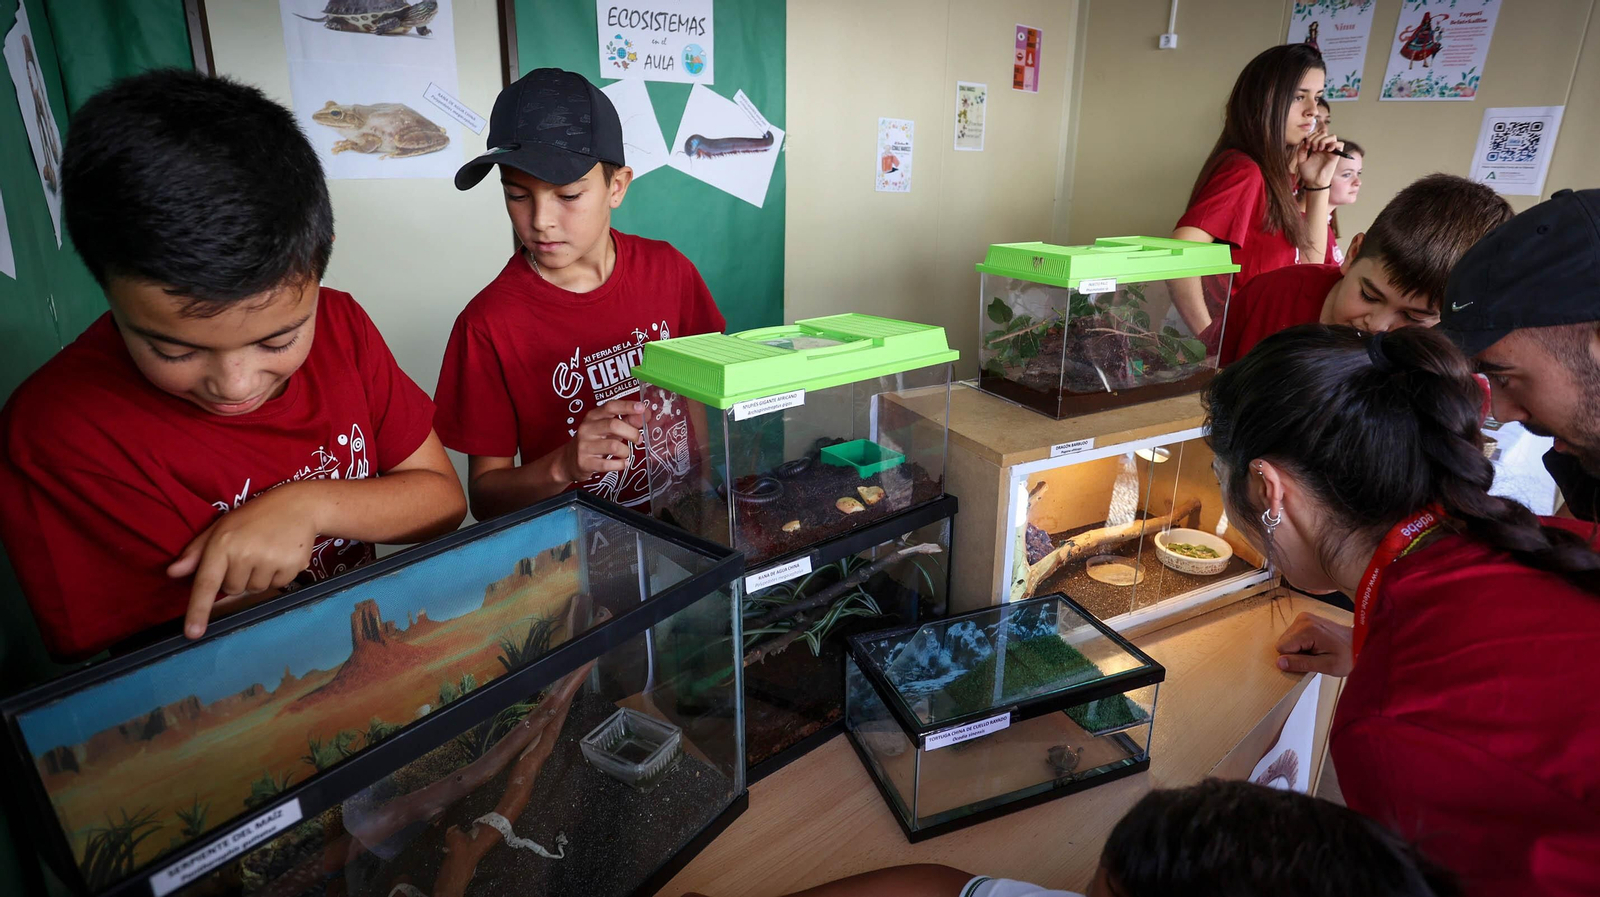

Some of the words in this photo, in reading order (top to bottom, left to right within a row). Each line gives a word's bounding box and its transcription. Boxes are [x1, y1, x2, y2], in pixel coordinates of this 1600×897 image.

[608, 6, 706, 36] ECOSISTEMAS
[644, 54, 674, 70] AULA
[592, 349, 612, 360] FERIA
[613, 344, 622, 352] DE
[622, 341, 632, 349] LA
[587, 348, 643, 390] CIENCI
[595, 392, 604, 400] EN
[605, 389, 614, 397] LA
[614, 382, 632, 393] CALLE
[759, 398, 776, 406] GIGANTE
[299, 466, 311, 477] LA
[1400, 513, 1434, 540] edebé
[929, 732, 951, 742] TORTUGA
[973, 721, 989, 730] CUELLO
[990, 716, 1008, 725] RAYADO
[167, 839, 229, 878] SERPIENTE
[232, 828, 252, 843] DEL
[254, 808, 283, 830] MAÍZ
